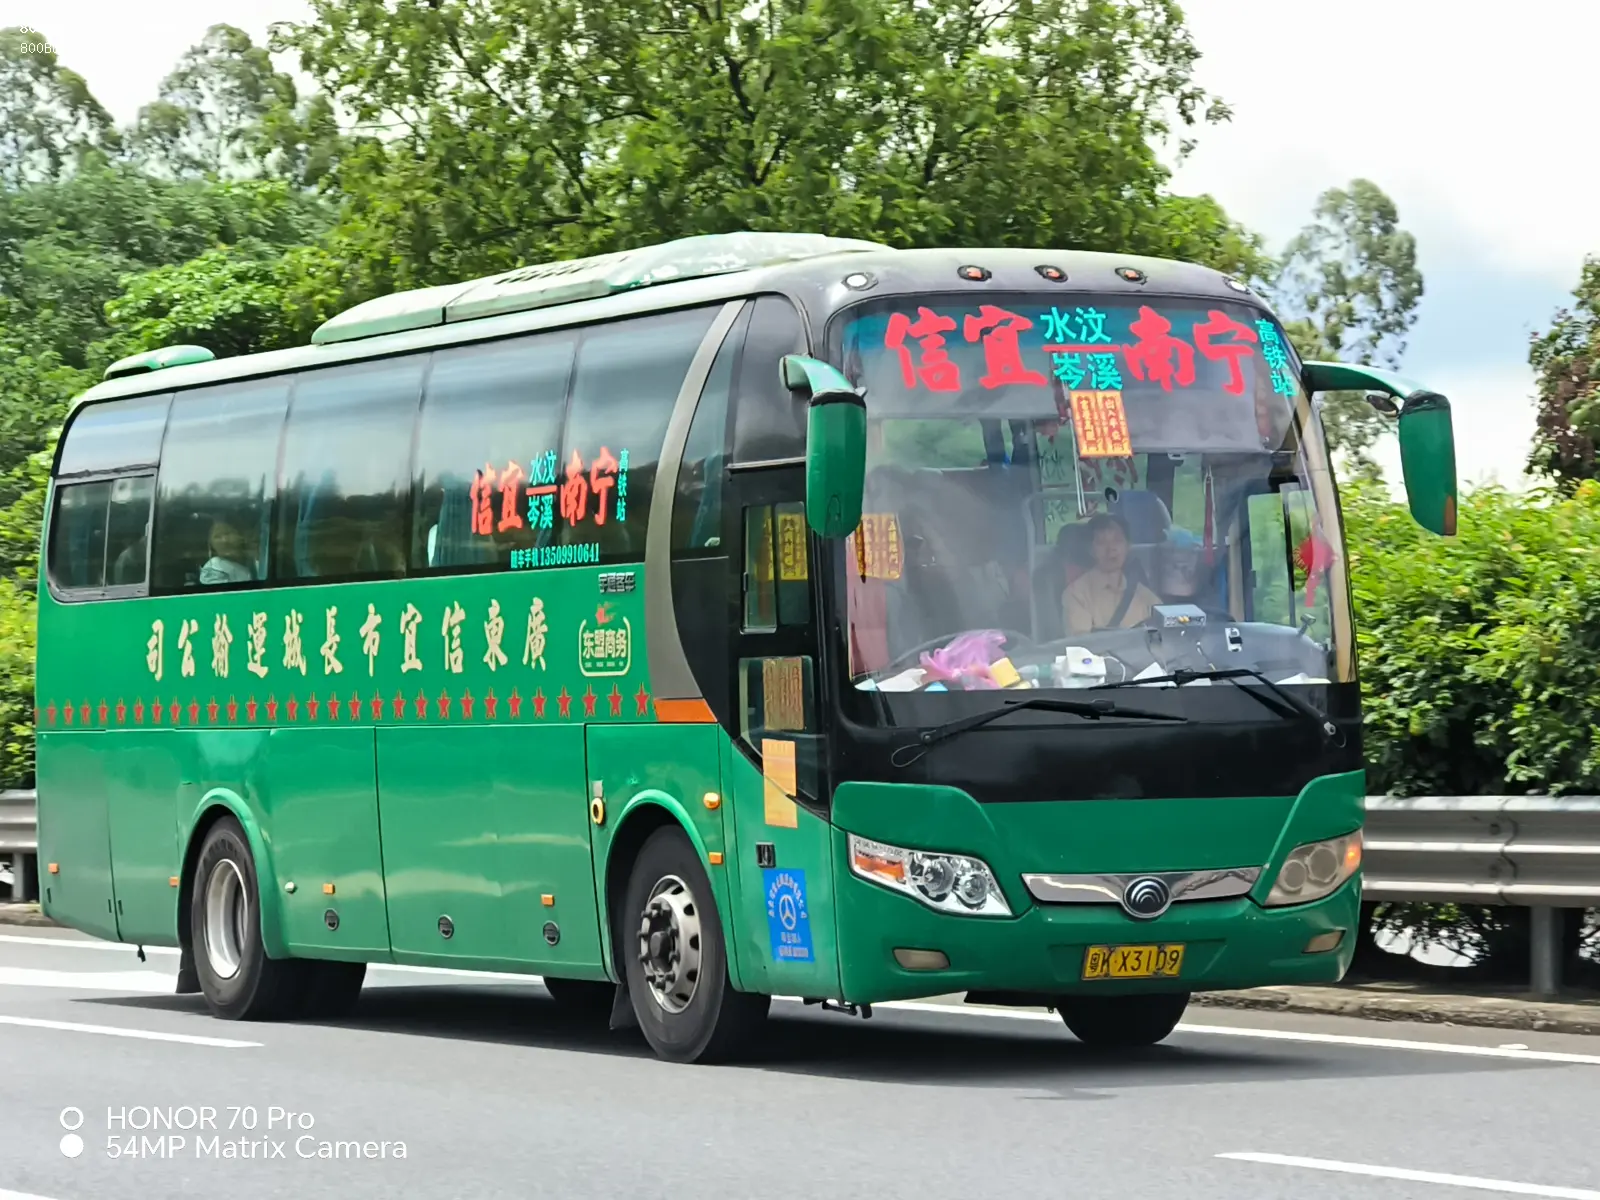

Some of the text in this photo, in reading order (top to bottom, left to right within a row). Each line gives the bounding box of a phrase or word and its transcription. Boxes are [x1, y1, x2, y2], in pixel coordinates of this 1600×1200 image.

[1040, 306, 1112, 344] 水汶
[884, 304, 1048, 392] 信宜
[1121, 305, 1258, 396] 南宁
[1052, 351, 1124, 392] 岑溪
[529, 450, 557, 485] 水汶
[560, 446, 618, 527] 南宁
[470, 460, 525, 535] 信宜
[527, 494, 554, 530] 岑溪
[582, 628, 628, 660] 东盟商务
